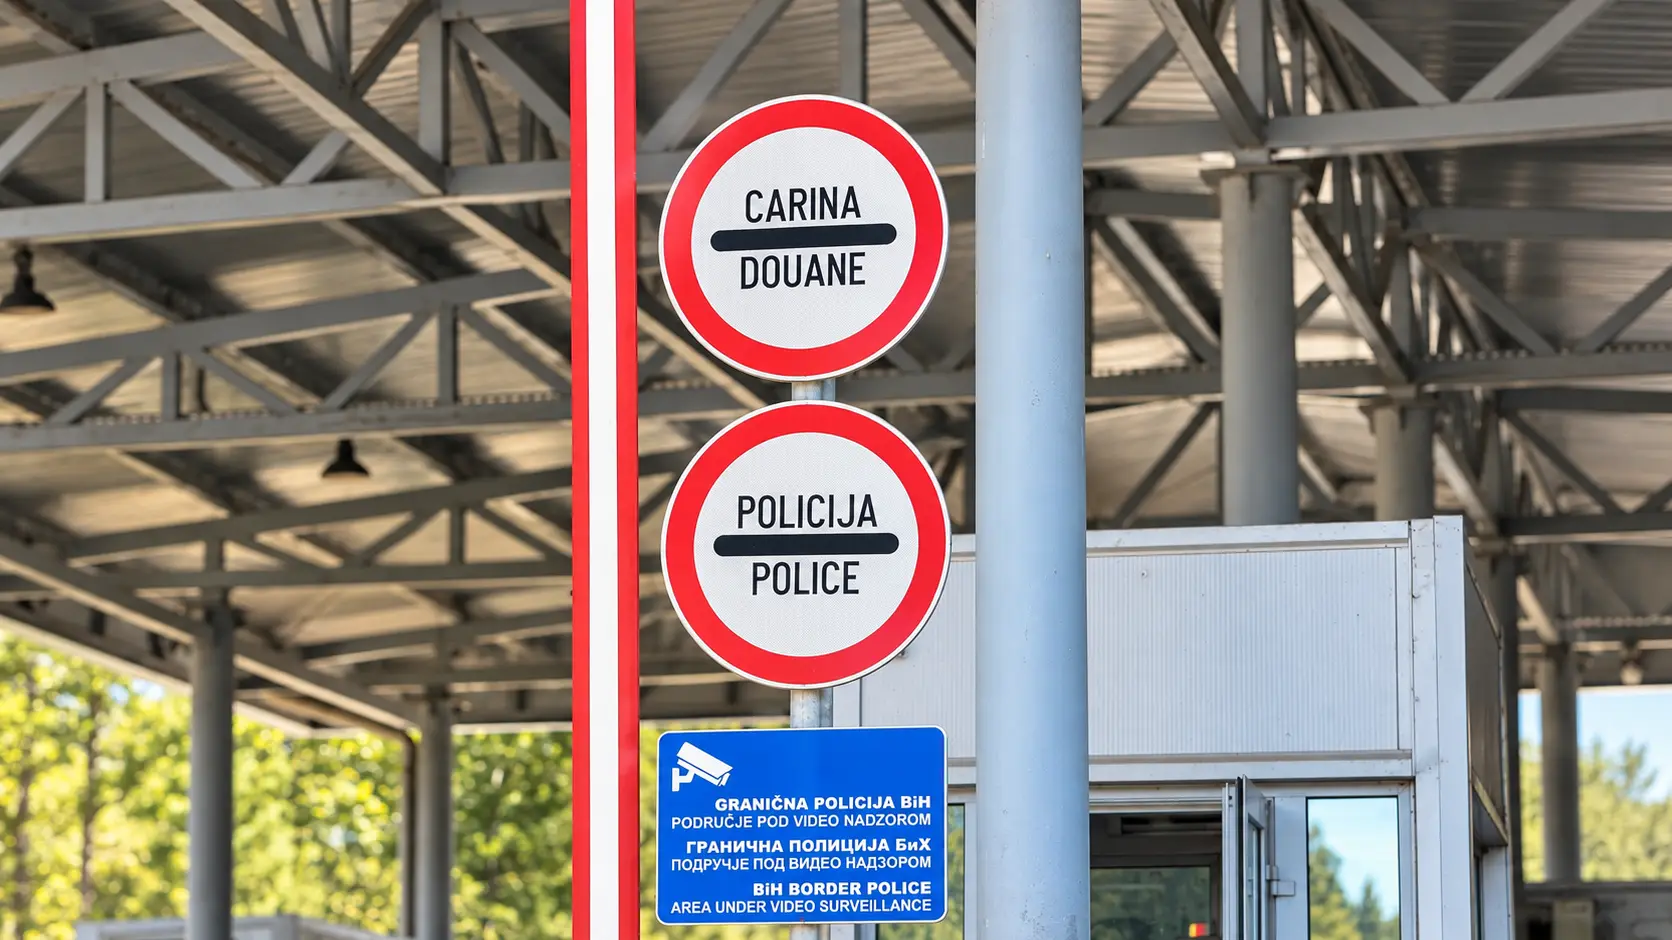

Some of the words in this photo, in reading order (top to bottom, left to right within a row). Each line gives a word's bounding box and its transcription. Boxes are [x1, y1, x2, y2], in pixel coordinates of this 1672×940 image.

[744, 186, 862, 224] CARINA
[740, 252, 866, 290] DOUANE
[737, 494, 878, 529] POLICIJA
[752, 561, 860, 596] POLICE
[715, 795, 808, 812] GRANIČNA
[814, 796, 894, 810] POLICIJA
[901, 796, 930, 809] BiH
[672, 813, 752, 829] PODRUČJE
[758, 816, 789, 828] POD
[793, 814, 839, 828] VIDEO
[844, 813, 931, 827] NADZOROM
[686, 840, 784, 854] ГРАНИЧНА
[789, 838, 889, 854] ПОЛИЦИЈА
[895, 838, 931, 851] БиХ
[671, 858, 749, 873] ПОДРУЧЈЕ
[754, 858, 785, 872] ПОД
[789, 857, 841, 871] ВИДЕО
[846, 856, 931, 870] НАДЗОРОМ
[753, 883, 782, 896] BiH
[789, 882, 862, 895] BORDER
[867, 881, 931, 894] POLICE
[670, 901, 712, 914] AREA
[715, 900, 766, 913] UNDER
[770, 900, 815, 913] VIDEO
[820, 899, 932, 912] SURVEILLANCE
